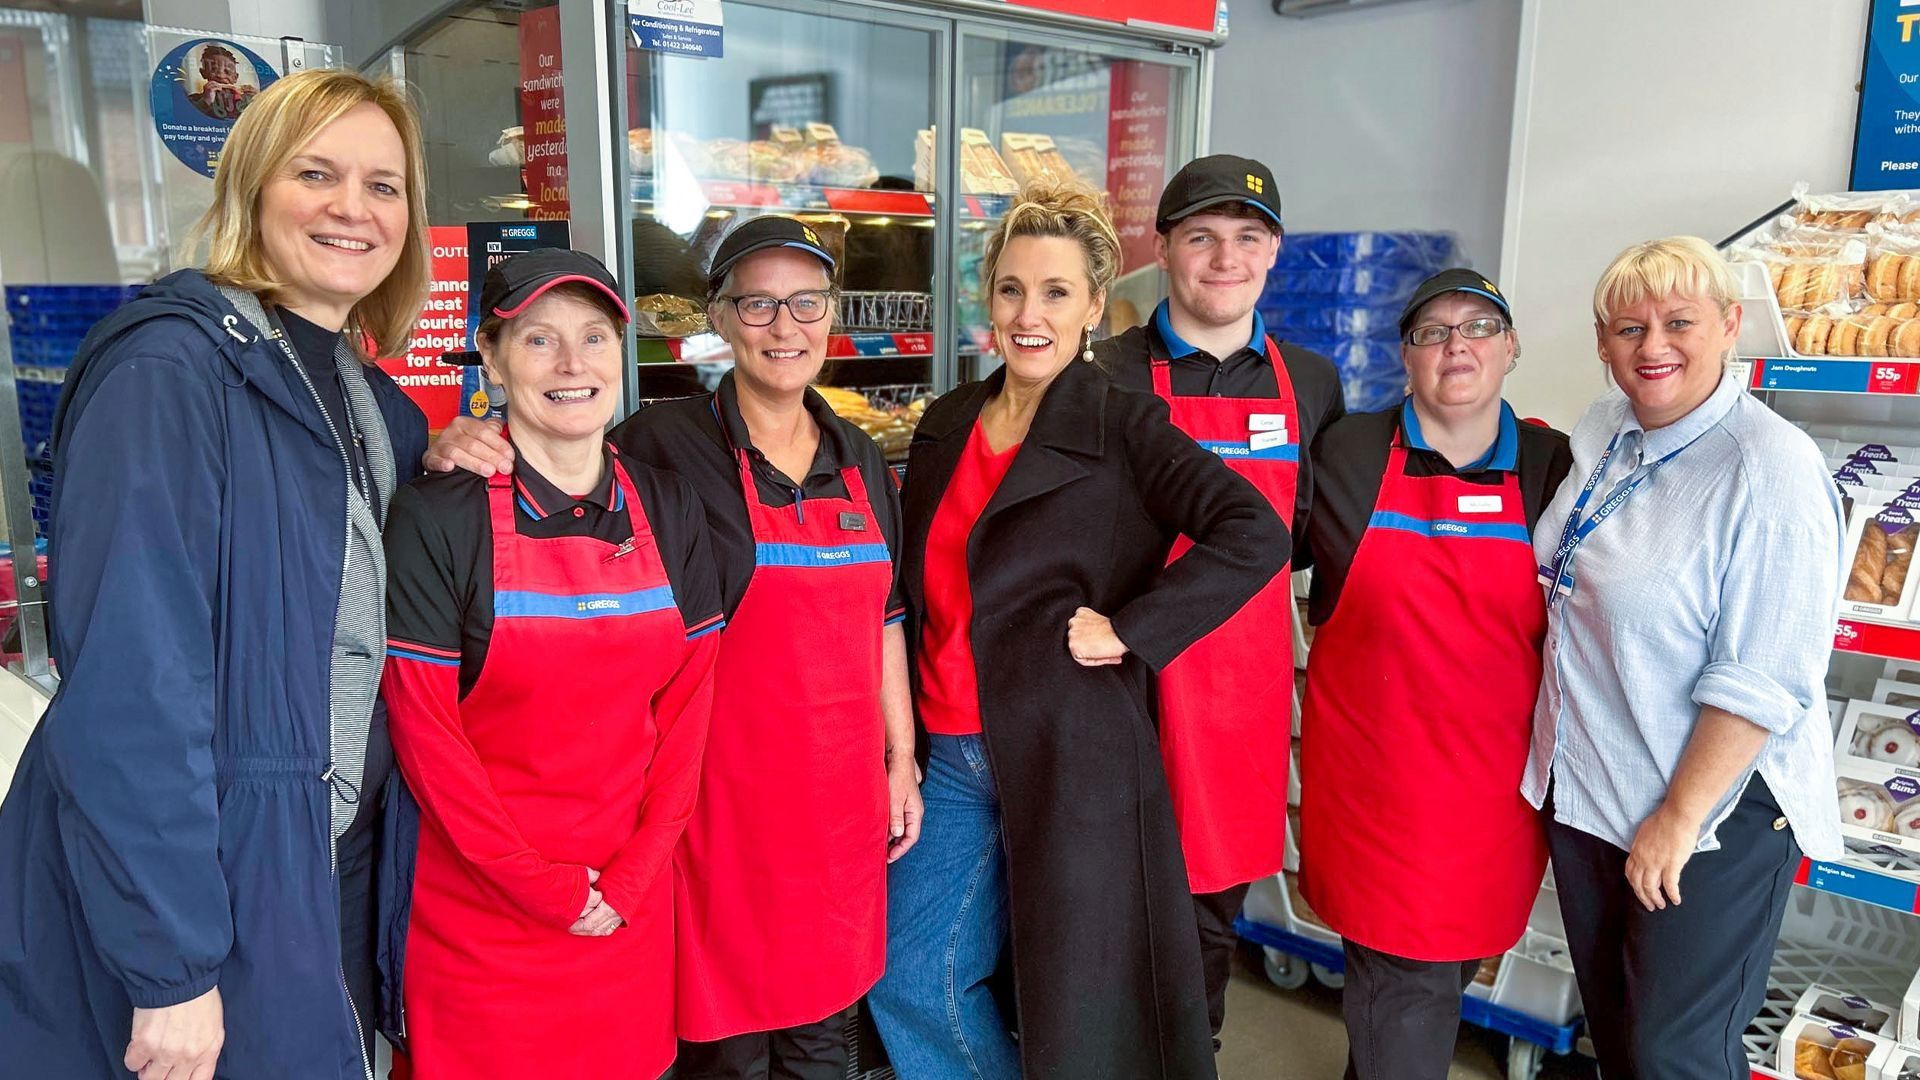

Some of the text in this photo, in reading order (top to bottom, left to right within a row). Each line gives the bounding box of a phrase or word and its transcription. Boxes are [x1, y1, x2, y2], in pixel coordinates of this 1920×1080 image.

[657, 0, 695, 15] Cool-Lec
[631, 18, 641, 26] Air
[641, 20, 677, 32] Conditioning
[685, 25, 720, 37] Refrigeration
[1896, 14, 1920, 42] T
[652, 39, 703, 52] Tel. 01422 340640
[538, 54, 554, 68] Our
[1899, 73, 1919, 84] Our
[540, 98, 560, 110] were
[162, 123, 187, 131] Donate
[193, 125, 226, 133] breakfast
[535, 118, 566, 135] made
[177, 134, 197, 142] today
[546, 163, 562, 177] in a
[1881, 161, 1918, 171] Please
[540, 181, 570, 202] local
[508, 228, 535, 237] GREGGS
[406, 353, 432, 368] for
[1770, 364, 1901, 382] Jam Doughnuts 55p
[1219, 446, 1250, 455] GREGGS
[1859, 450, 1889, 460] Treats
[1584, 458, 1606, 492] GREGGS
[1844, 465, 1874, 475] Treats
[1600, 485, 1634, 517] GREGGS
[1878, 513, 1911, 525] Treats
[1436, 523, 1468, 534] GREGGS
[821, 550, 851, 560] GREGGS
[587, 599, 620, 611] GREGGS
[1889, 782, 1917, 795] Buns
[1817, 865, 1856, 879] Belgian Buns
